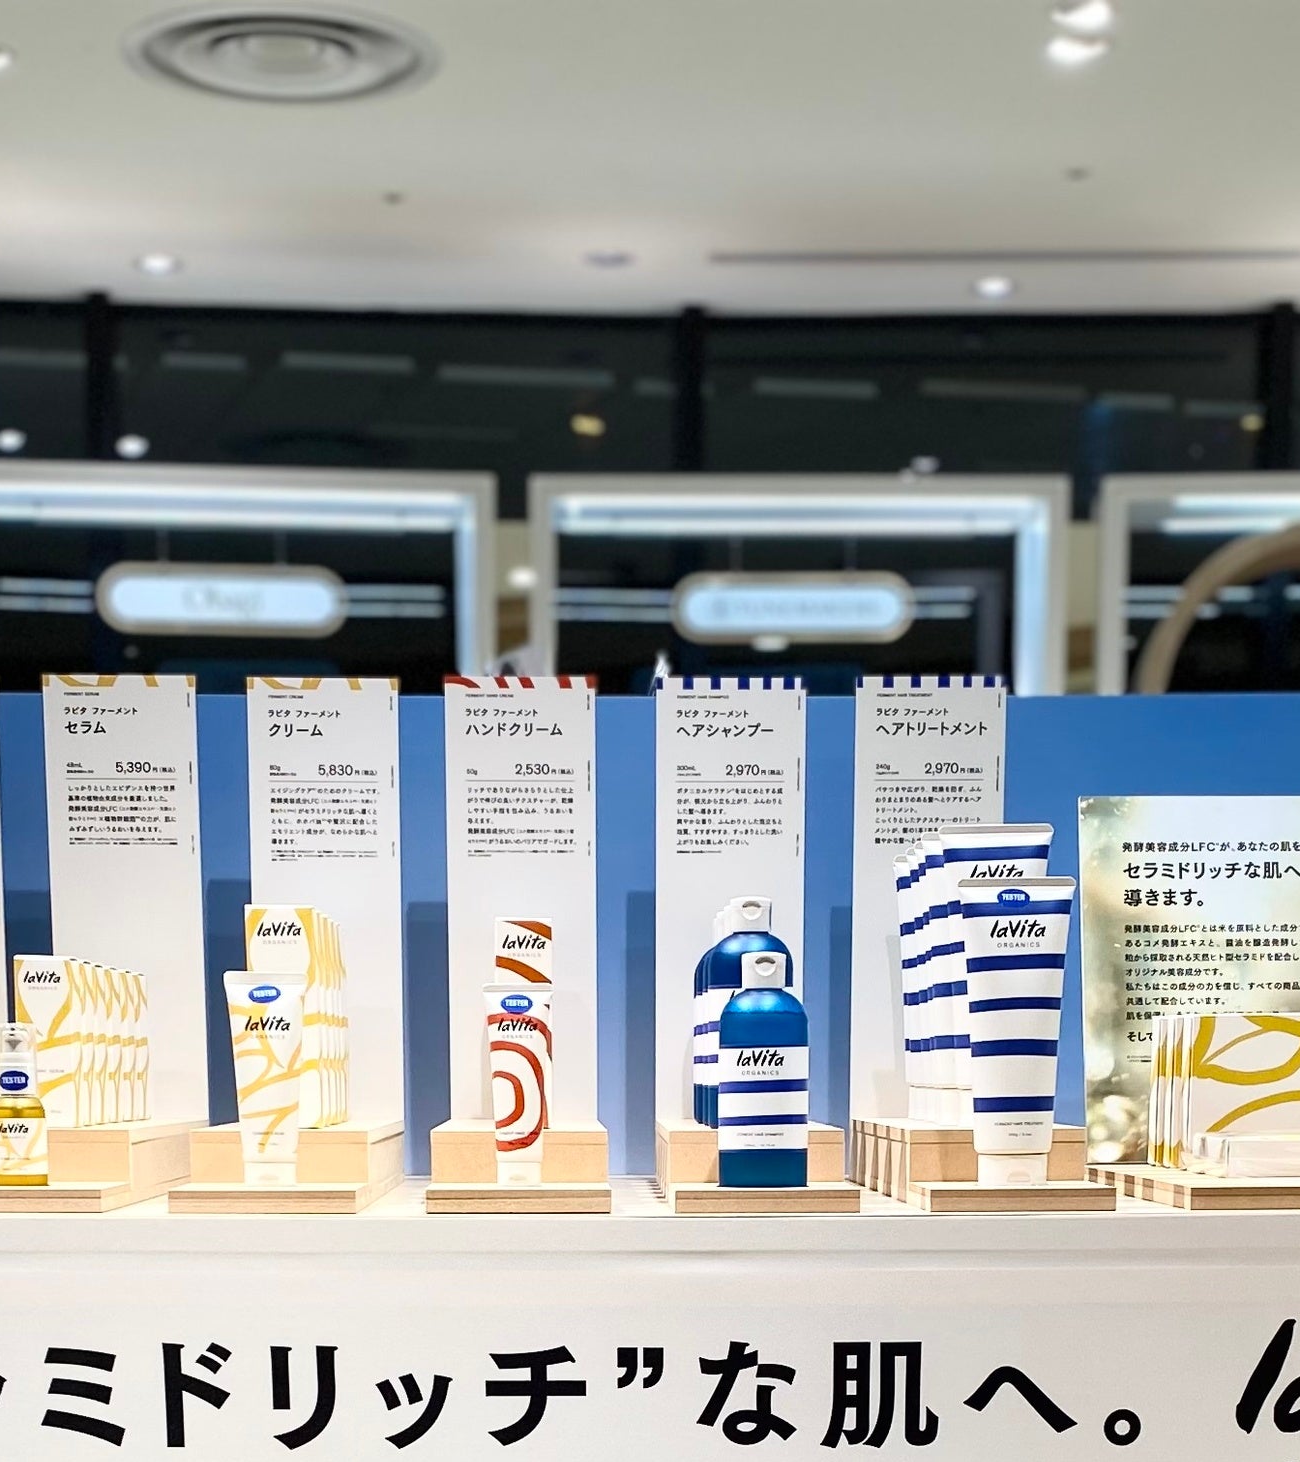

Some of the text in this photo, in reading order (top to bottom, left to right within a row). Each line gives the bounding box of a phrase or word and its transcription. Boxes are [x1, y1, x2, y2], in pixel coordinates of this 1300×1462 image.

[63, 706, 138, 716] ラビタ ファーメント
[267, 709, 341, 719] ラビタ ファーメント
[465, 707, 539, 718] ラビタ ファーメント
[676, 709, 749, 719] ラビタ ファーメント
[876, 707, 949, 717] ラビタ ファーメント
[65, 721, 106, 734] セラム
[269, 724, 323, 737] クリーム
[466, 723, 562, 736] ハンドクリーム
[677, 723, 773, 738] ヘアシャンプー
[876, 722, 987, 736] ヘアトリートメント
[1124, 889, 1203, 907] 導きます。
[257, 922, 301, 936] laVita
[990, 919, 1046, 938] laVita
[502, 932, 548, 949] laVita
[24, 971, 60, 983] laVita
[245, 1016, 290, 1031] laVita
[735, 1048, 784, 1066] laVita
[0, 1124, 28, 1133] laVita
